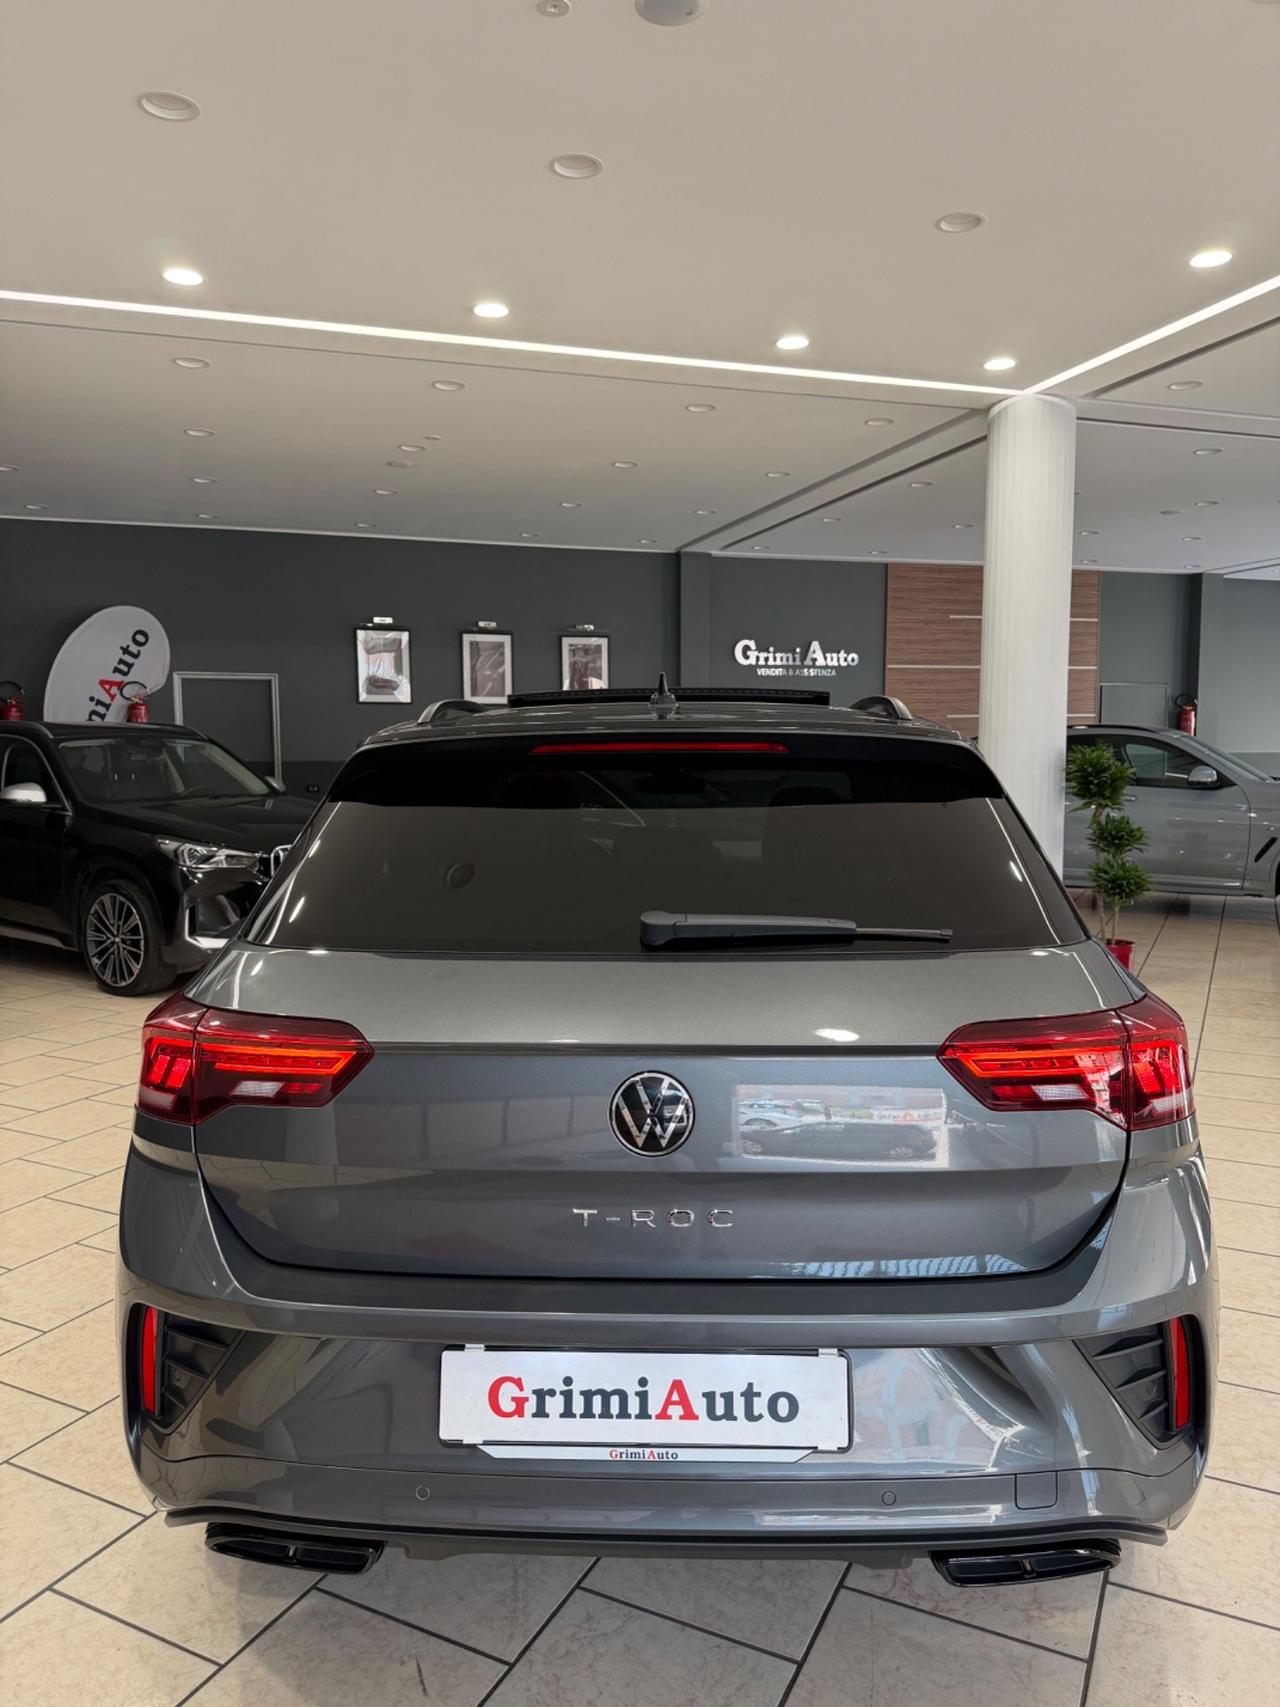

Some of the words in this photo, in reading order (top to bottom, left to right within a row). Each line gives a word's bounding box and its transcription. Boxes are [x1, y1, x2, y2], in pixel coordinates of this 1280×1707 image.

[756, 667, 787, 677] VENDITA
[795, 667, 837, 677] ASSSTENZA
[572, 1208, 735, 1228] T-ROC
[487, 1376, 799, 1423] GrimiAuto
[609, 1449, 679, 1460] GrimiAuto
